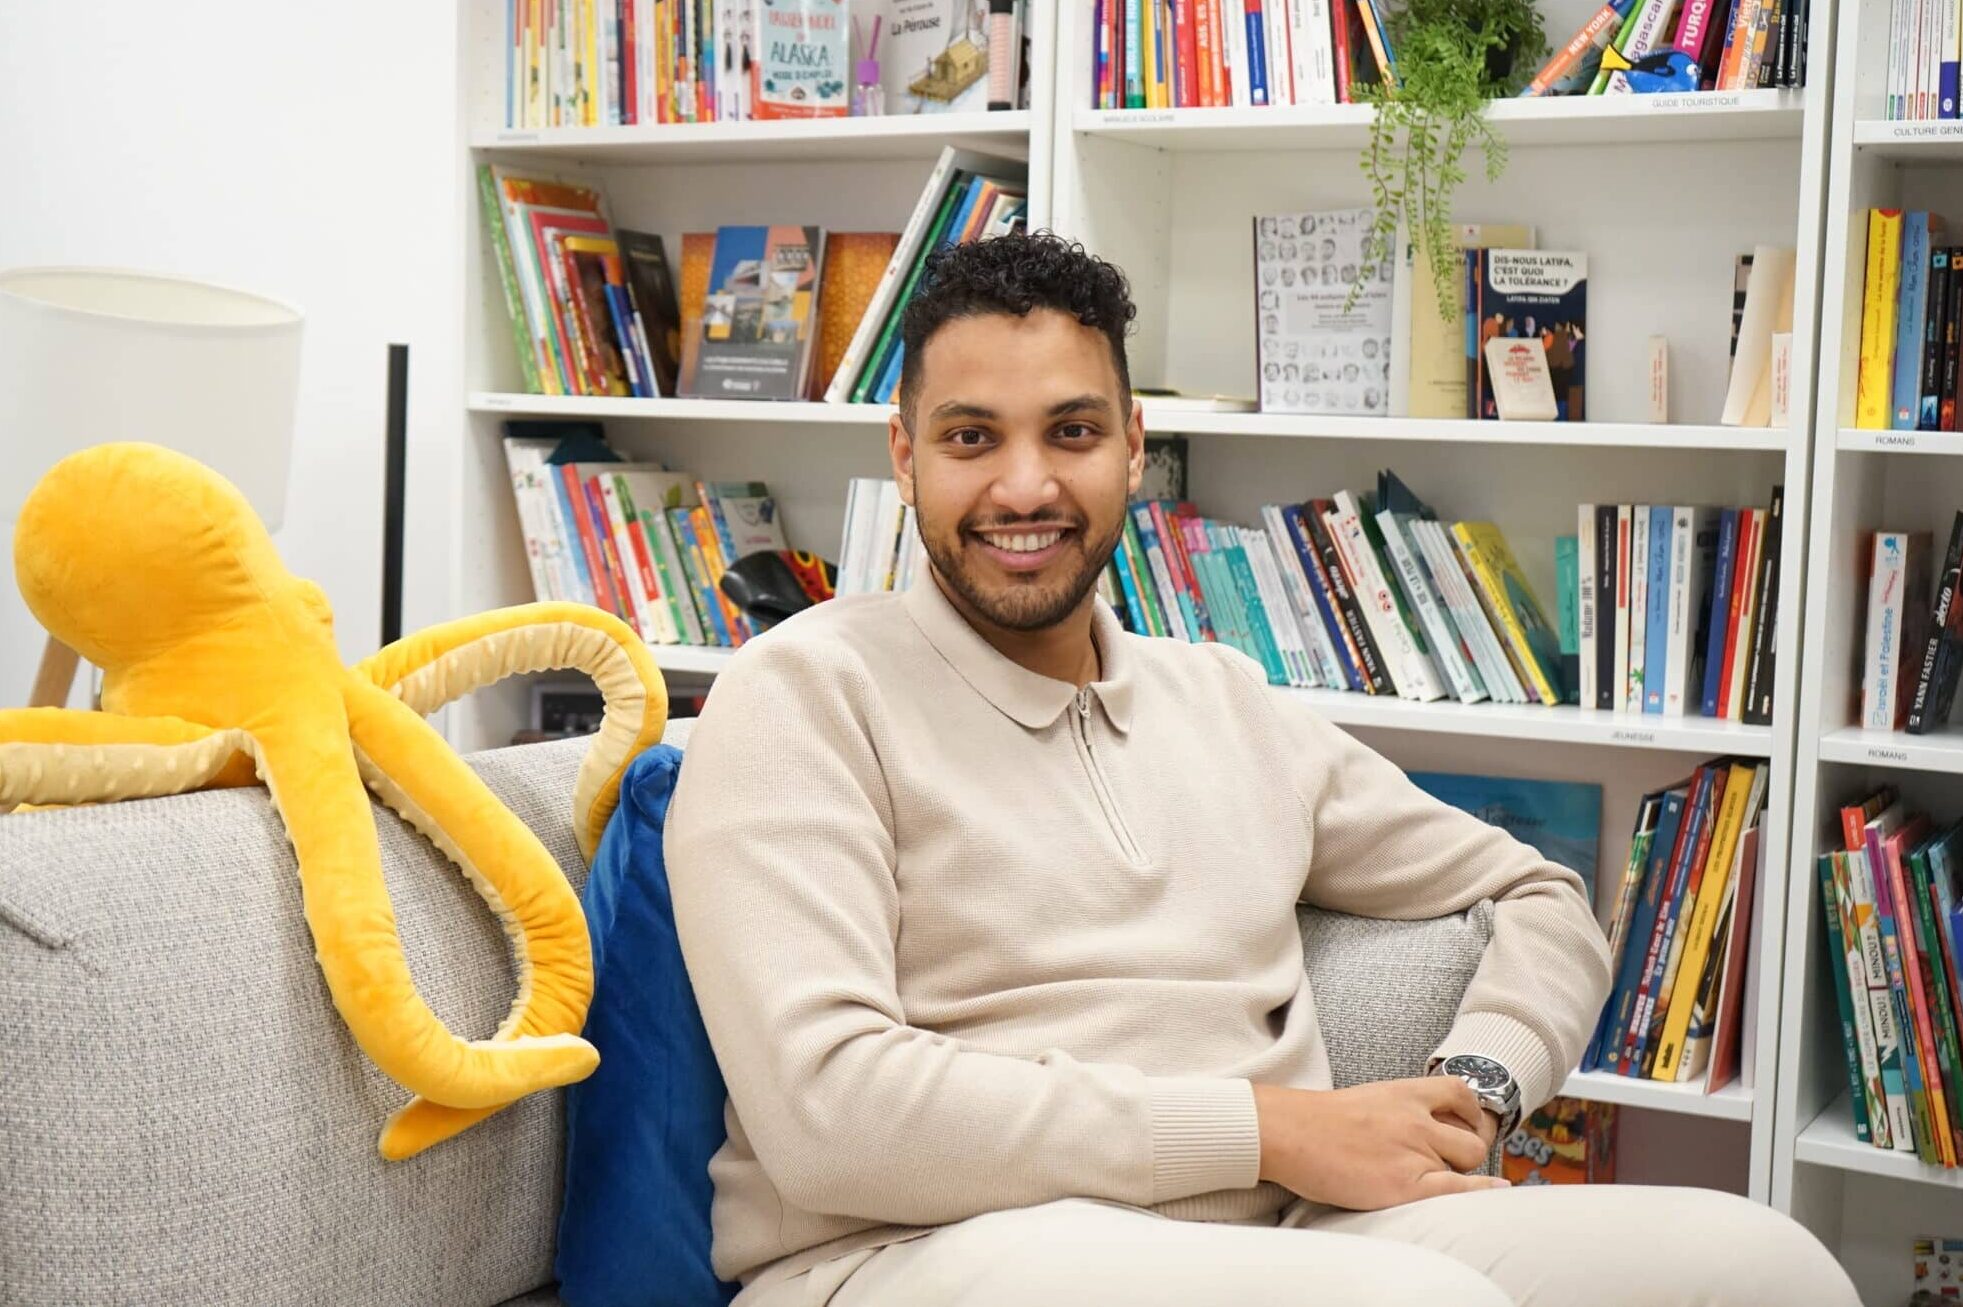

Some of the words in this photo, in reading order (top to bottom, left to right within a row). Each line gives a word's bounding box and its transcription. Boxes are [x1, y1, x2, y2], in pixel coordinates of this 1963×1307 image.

[1565, 31, 1589, 56] NEW
[1583, 7, 1612, 36] YORK
[770, 41, 830, 67] ALASKA
[1653, 99, 1678, 107] GUIDE
[1682, 97, 1740, 107] TOURISTIQUE
[1894, 126, 1937, 136] CULTURE
[1494, 256, 1537, 265] DIS-NOUS
[1540, 257, 1573, 267] LATIFA,
[1521, 267, 1544, 276] QUOI
[1494, 277, 1506, 285] LA
[1509, 277, 1560, 287] TOLÉRANCE
[1875, 436, 1915, 446] ROMANS
[1344, 608, 1366, 647] FASTIER
[1359, 645, 1376, 673] YANN
[1919, 636, 1939, 680] FASTIER
[1912, 680, 1928, 710] YANN
[1612, 732, 1655, 742] JEUNESSE
[1868, 750, 1907, 761] ROMANS
